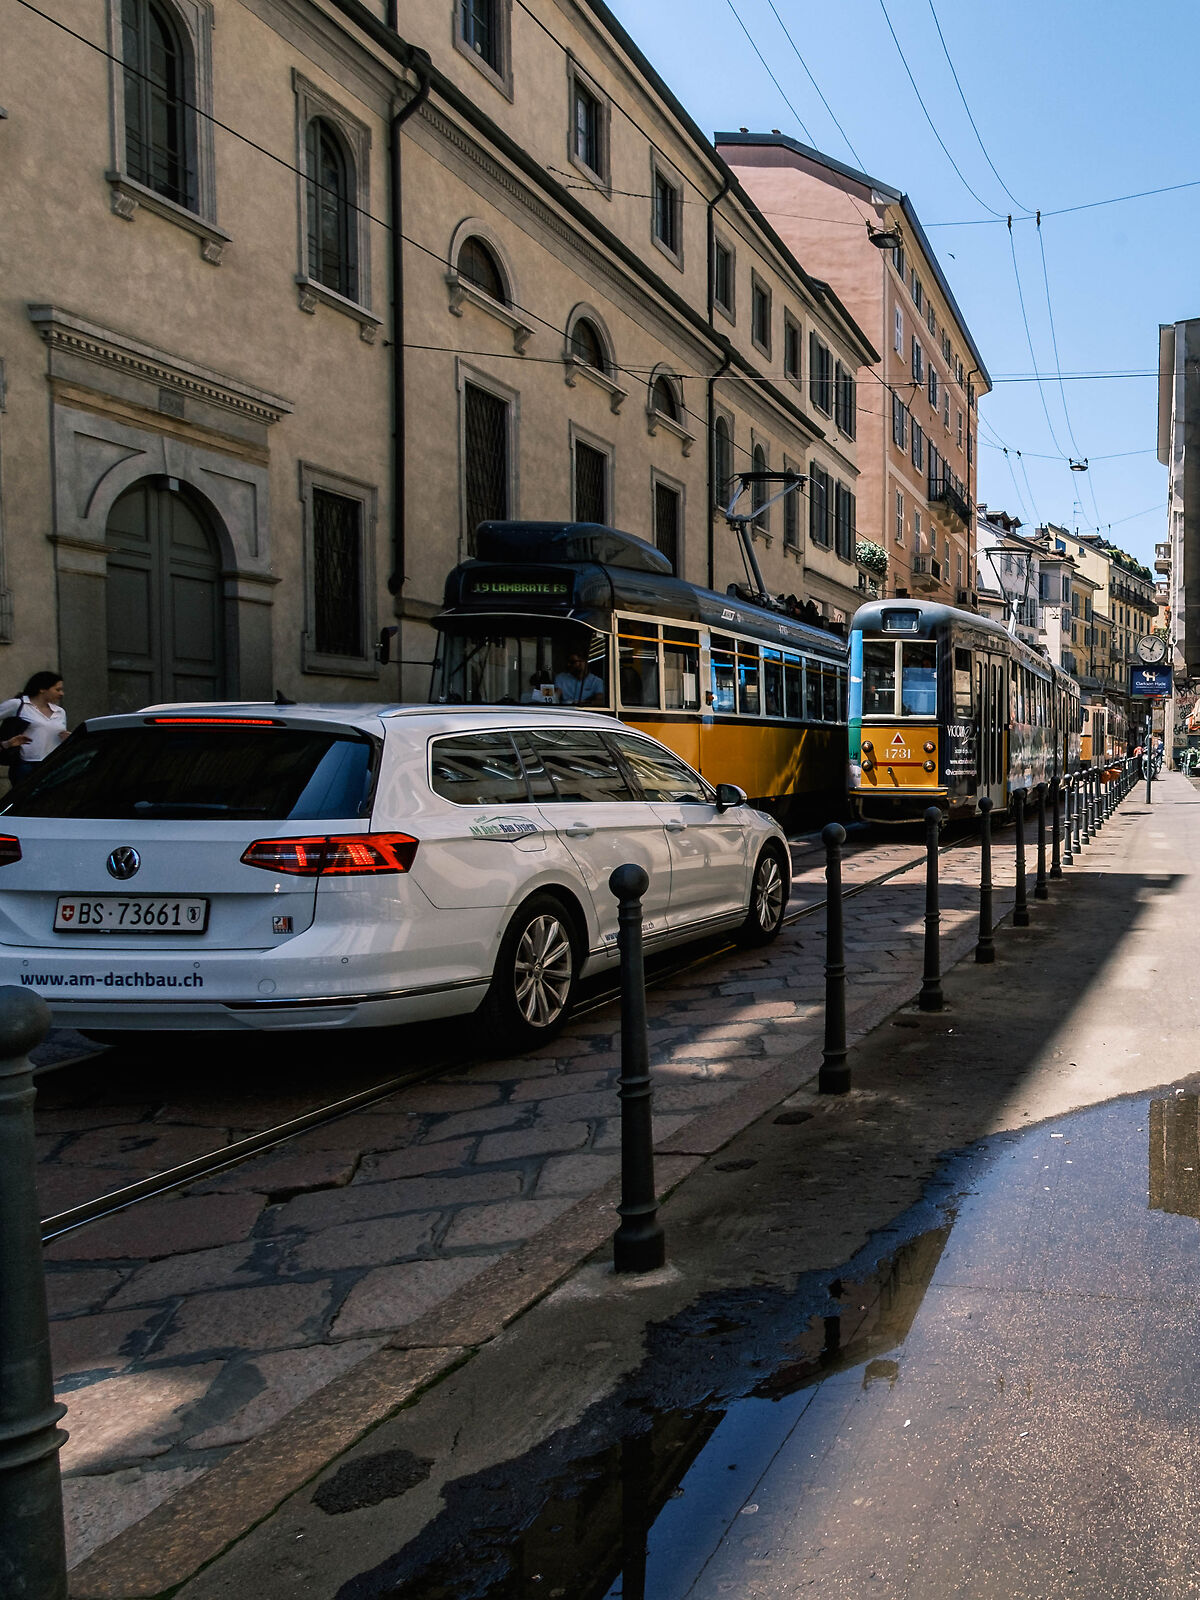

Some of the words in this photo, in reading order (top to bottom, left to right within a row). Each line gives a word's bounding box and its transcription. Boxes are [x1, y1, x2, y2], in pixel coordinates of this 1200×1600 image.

[492, 583, 550, 593] LAMBRATE
[553, 584, 568, 593] FS
[20, 971, 204, 987] www.am-dachbau.ch
